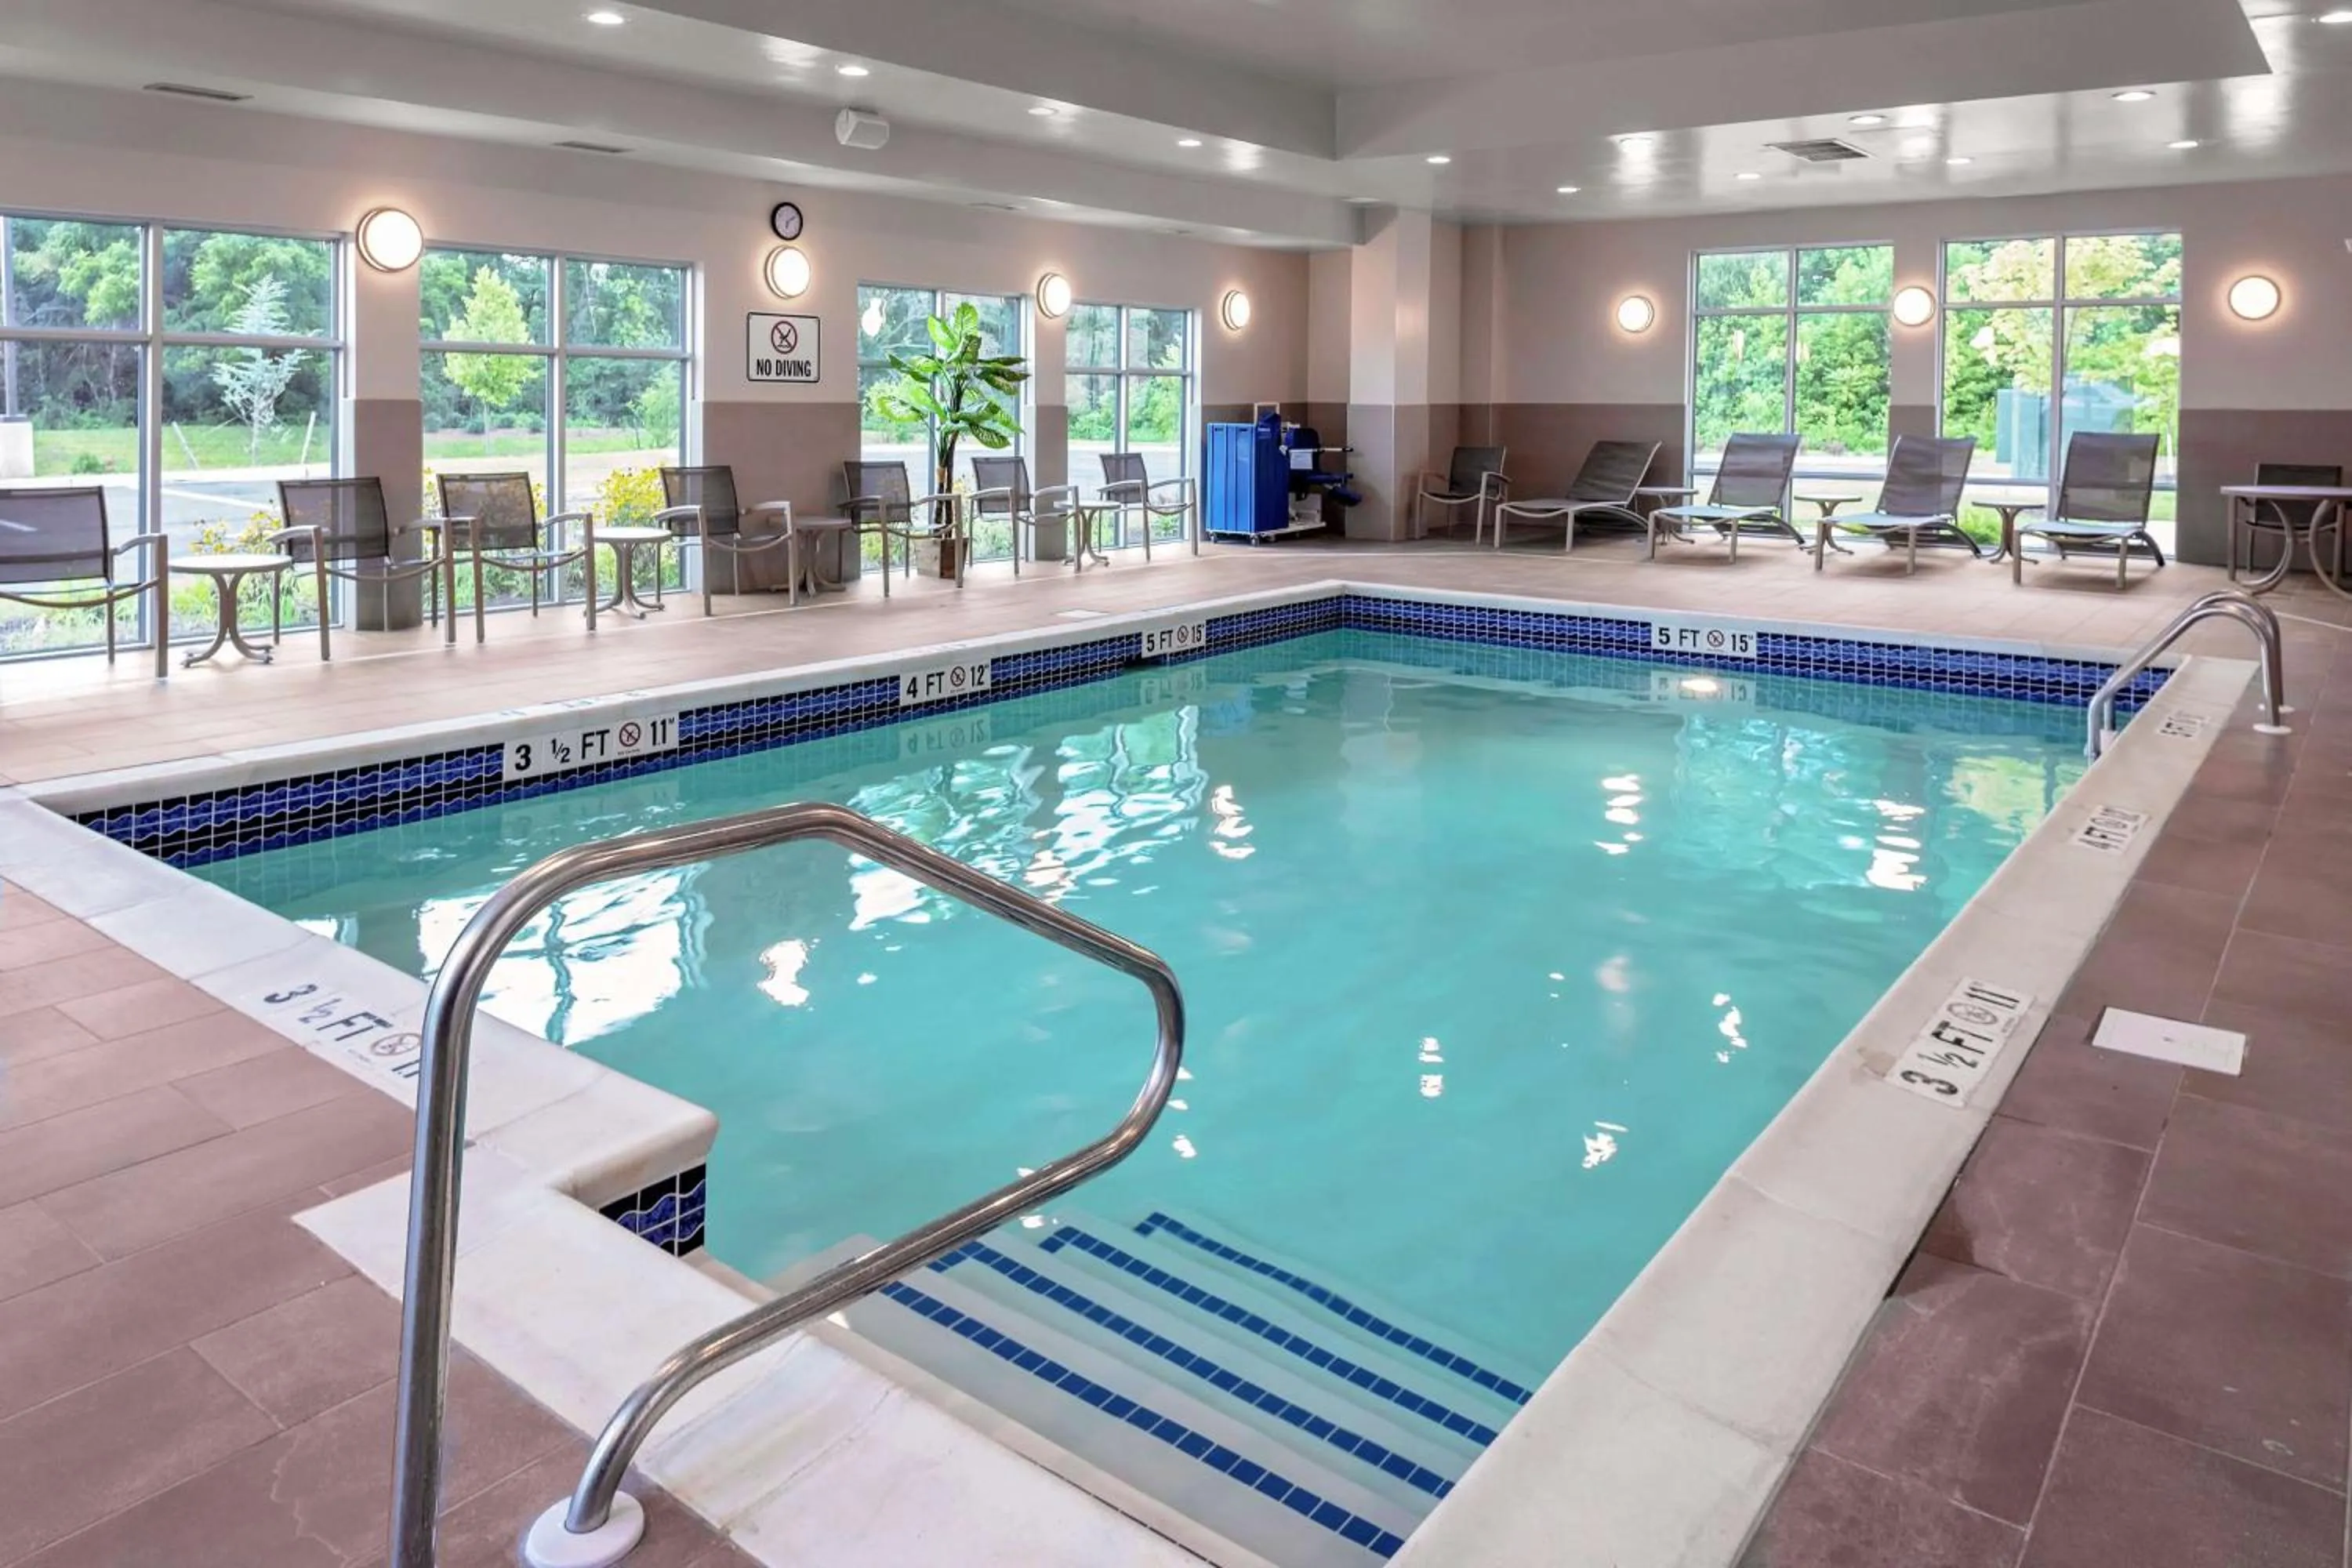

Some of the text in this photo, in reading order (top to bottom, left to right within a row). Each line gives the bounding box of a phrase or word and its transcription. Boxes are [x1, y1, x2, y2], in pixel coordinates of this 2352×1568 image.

[757, 358, 811, 377] NO DIVING
[1147, 633, 1155, 652] 5
[1160, 630, 1174, 650] FT
[1658, 626, 1671, 645] 5
[1679, 628, 1700, 648] FT
[906, 677, 918, 699] 4
[926, 671, 945, 696] FT
[514, 744, 532, 771] 3
[580, 729, 610, 760] FT
[263, 983, 319, 1004] 3
[315, 1011, 394, 1042] FT
[1900, 1069, 1959, 1096] 3
[1930, 1020, 1994, 1055] FT
